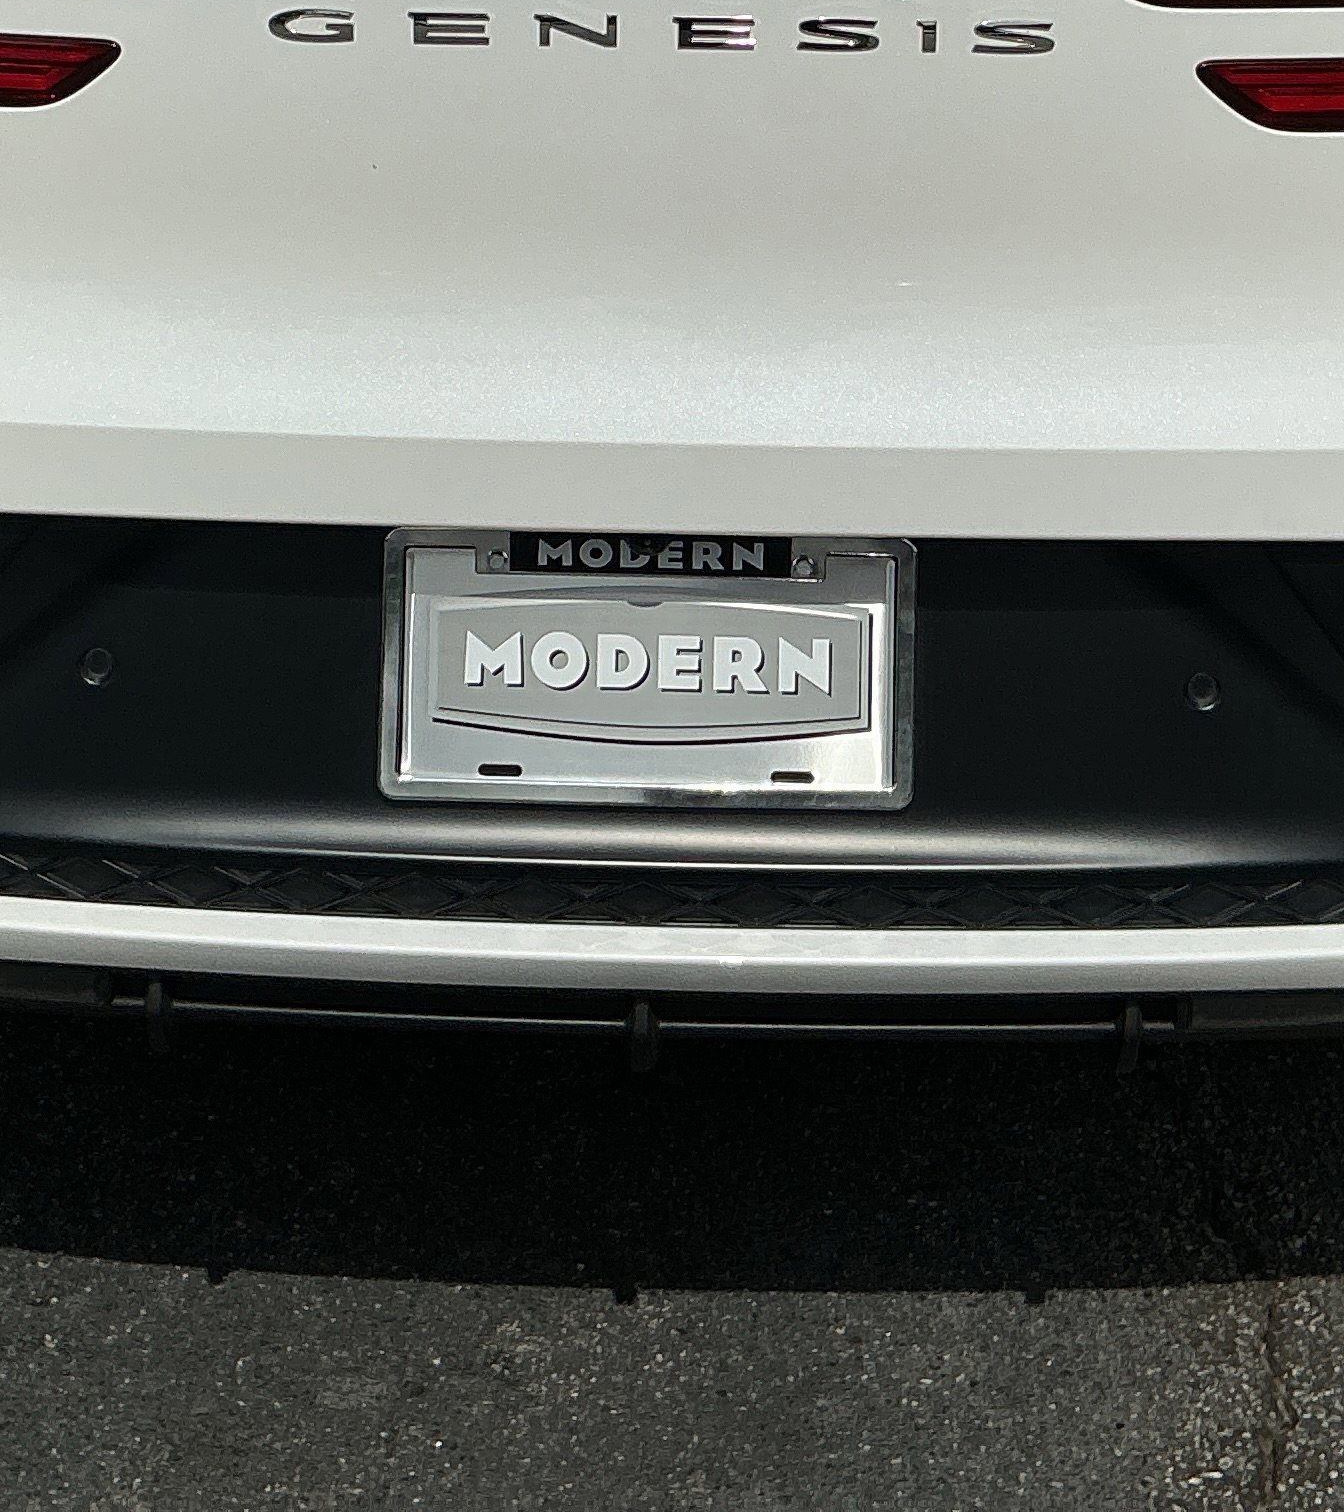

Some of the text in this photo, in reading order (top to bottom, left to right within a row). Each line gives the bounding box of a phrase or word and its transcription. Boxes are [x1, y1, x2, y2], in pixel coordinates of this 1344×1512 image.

[268, 8, 1056, 55] GENESIS
[537, 538, 765, 571] MODERN
[463, 630, 833, 695] MODERN
